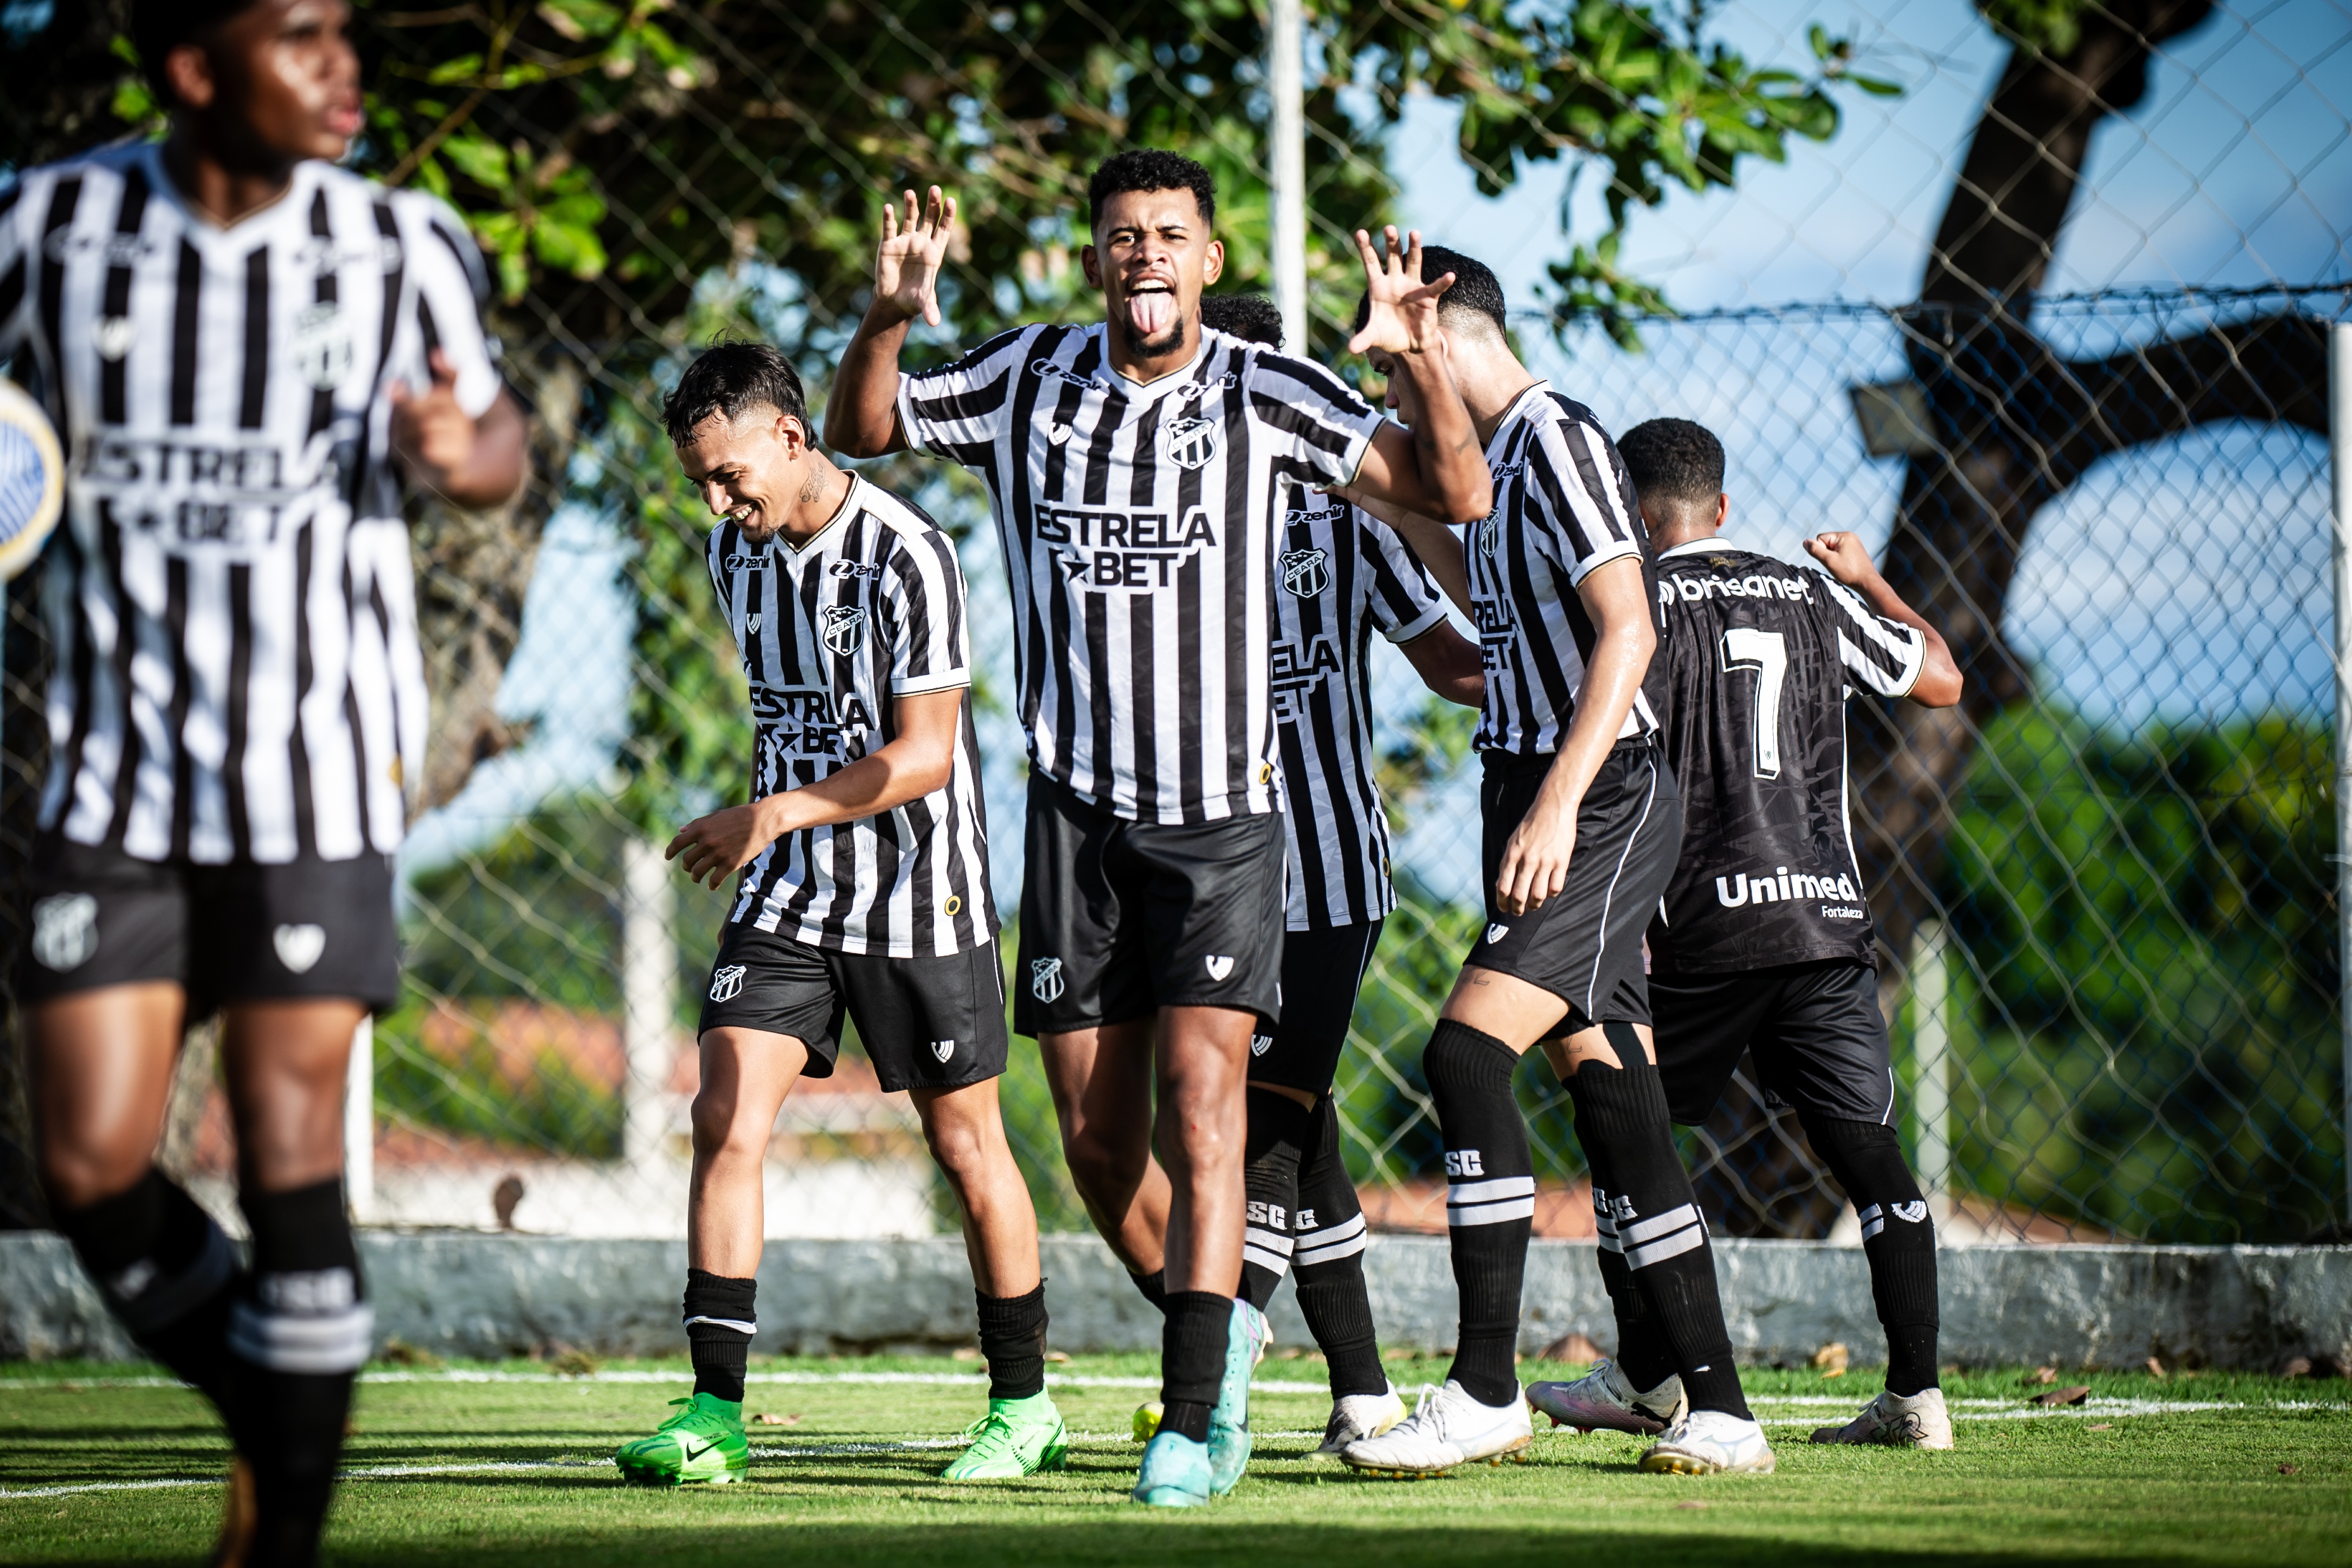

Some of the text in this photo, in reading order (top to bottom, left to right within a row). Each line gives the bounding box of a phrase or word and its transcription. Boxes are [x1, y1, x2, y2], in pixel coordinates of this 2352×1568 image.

[1035, 503, 1217, 548] ESTRELA
[1303, 506, 1343, 521] zenir
[746, 555, 770, 569] zenir
[856, 563, 880, 579] zenir
[1094, 551, 1179, 587] BET
[1671, 573, 1814, 605] brisanet
[1470, 598, 1520, 634] RELA
[1272, 640, 1341, 681] ELA
[1273, 679, 1309, 718] ET
[1719, 628, 1787, 780] 7
[1716, 866, 1858, 908] Unimed
[1821, 905, 1864, 920] Fortaleza
[1445, 1149, 1485, 1177] SC
[1246, 1201, 1287, 1230] SC
